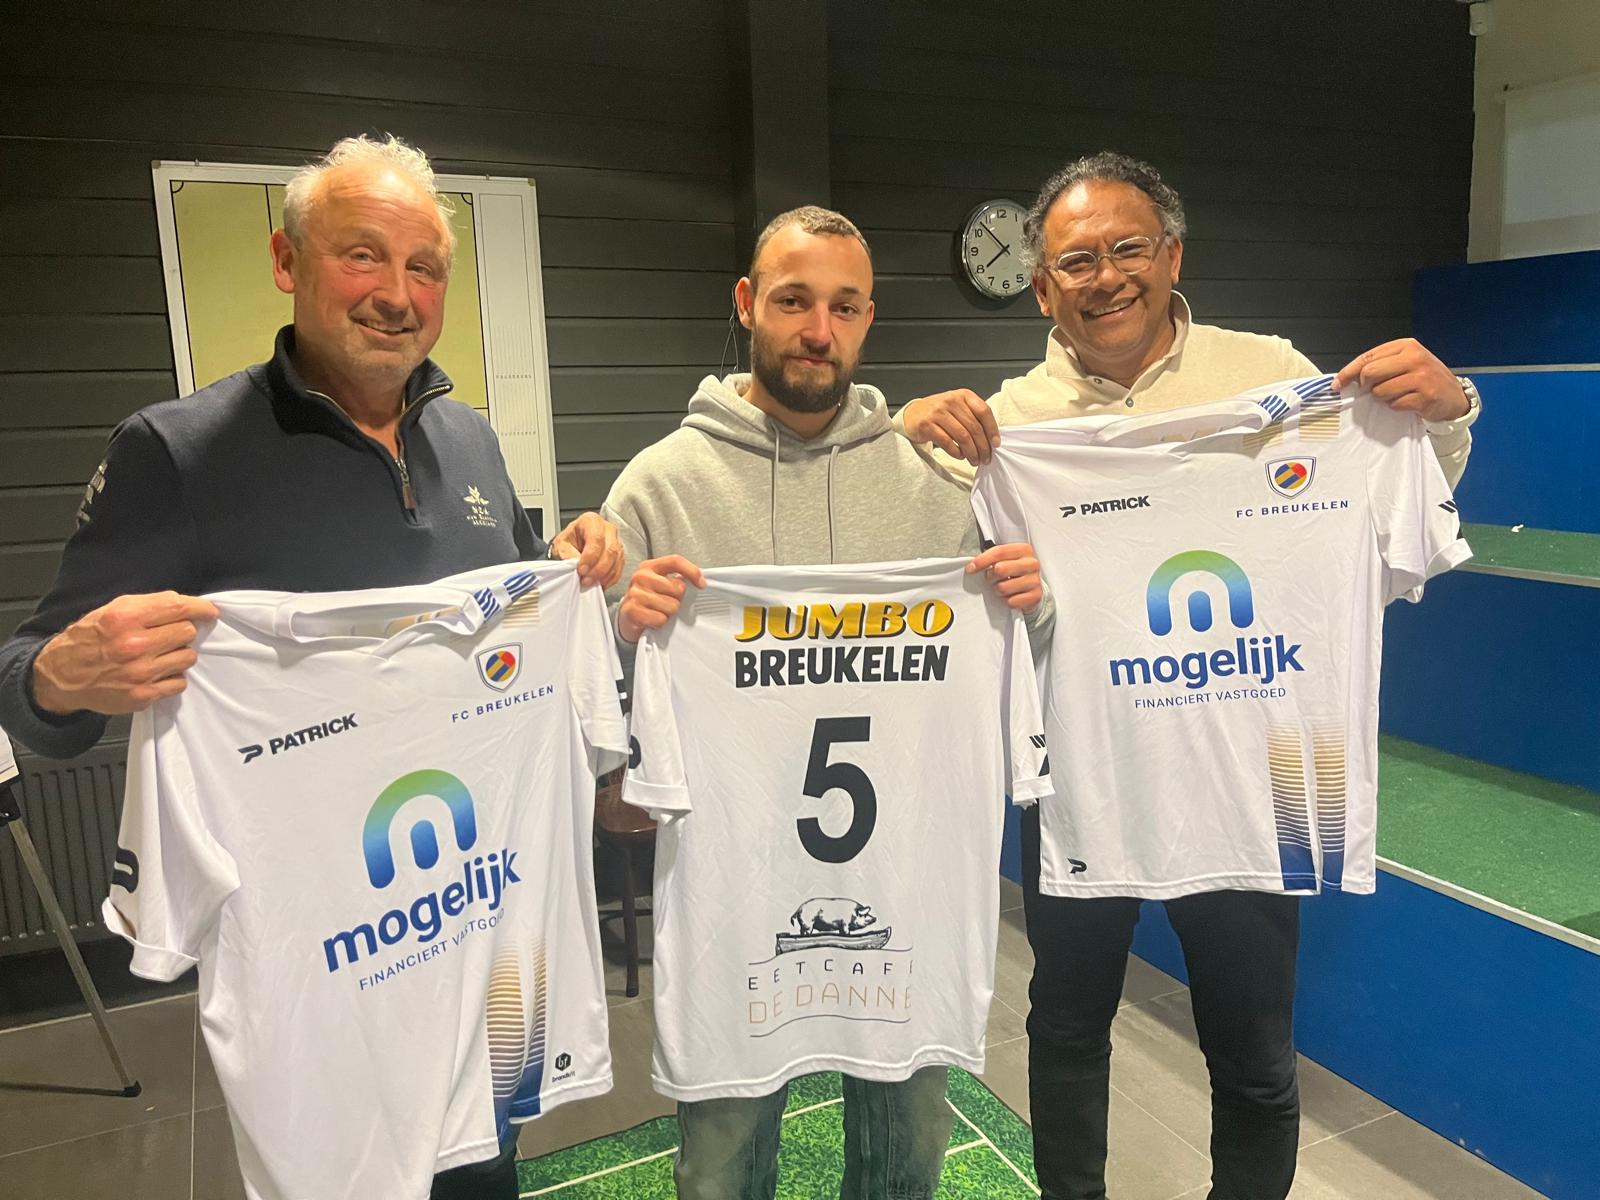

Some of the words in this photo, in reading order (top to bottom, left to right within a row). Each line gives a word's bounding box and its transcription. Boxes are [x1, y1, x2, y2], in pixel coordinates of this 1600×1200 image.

[997, 209, 1007, 219] 12
[974, 228, 983, 238] 10
[970, 246, 979, 256] 9
[976, 264, 985, 274] 8
[1016, 273, 1024, 283] 5
[988, 276, 995, 286] 7
[1002, 279, 1010, 289] 6
[1080, 495, 1151, 516] PATRICK
[1236, 508, 1254, 519] FC
[1261, 499, 1349, 517] BREUKELEN
[734, 599, 955, 643] JUMBO
[735, 645, 950, 689] BREUKELEN
[1109, 634, 1305, 689] mogelijk
[451, 709, 470, 723] FC
[476, 684, 555, 716] BREUKELEN
[1135, 693, 1211, 709] FINANCIERT
[1216, 687, 1286, 701] VASTGOED
[268, 712, 359, 755] PATRICK
[796, 716, 878, 864] 5
[323, 848, 521, 973] mogelijk
[359, 940, 448, 991] FINANCIERT
[748, 959, 913, 991] EETCAF
